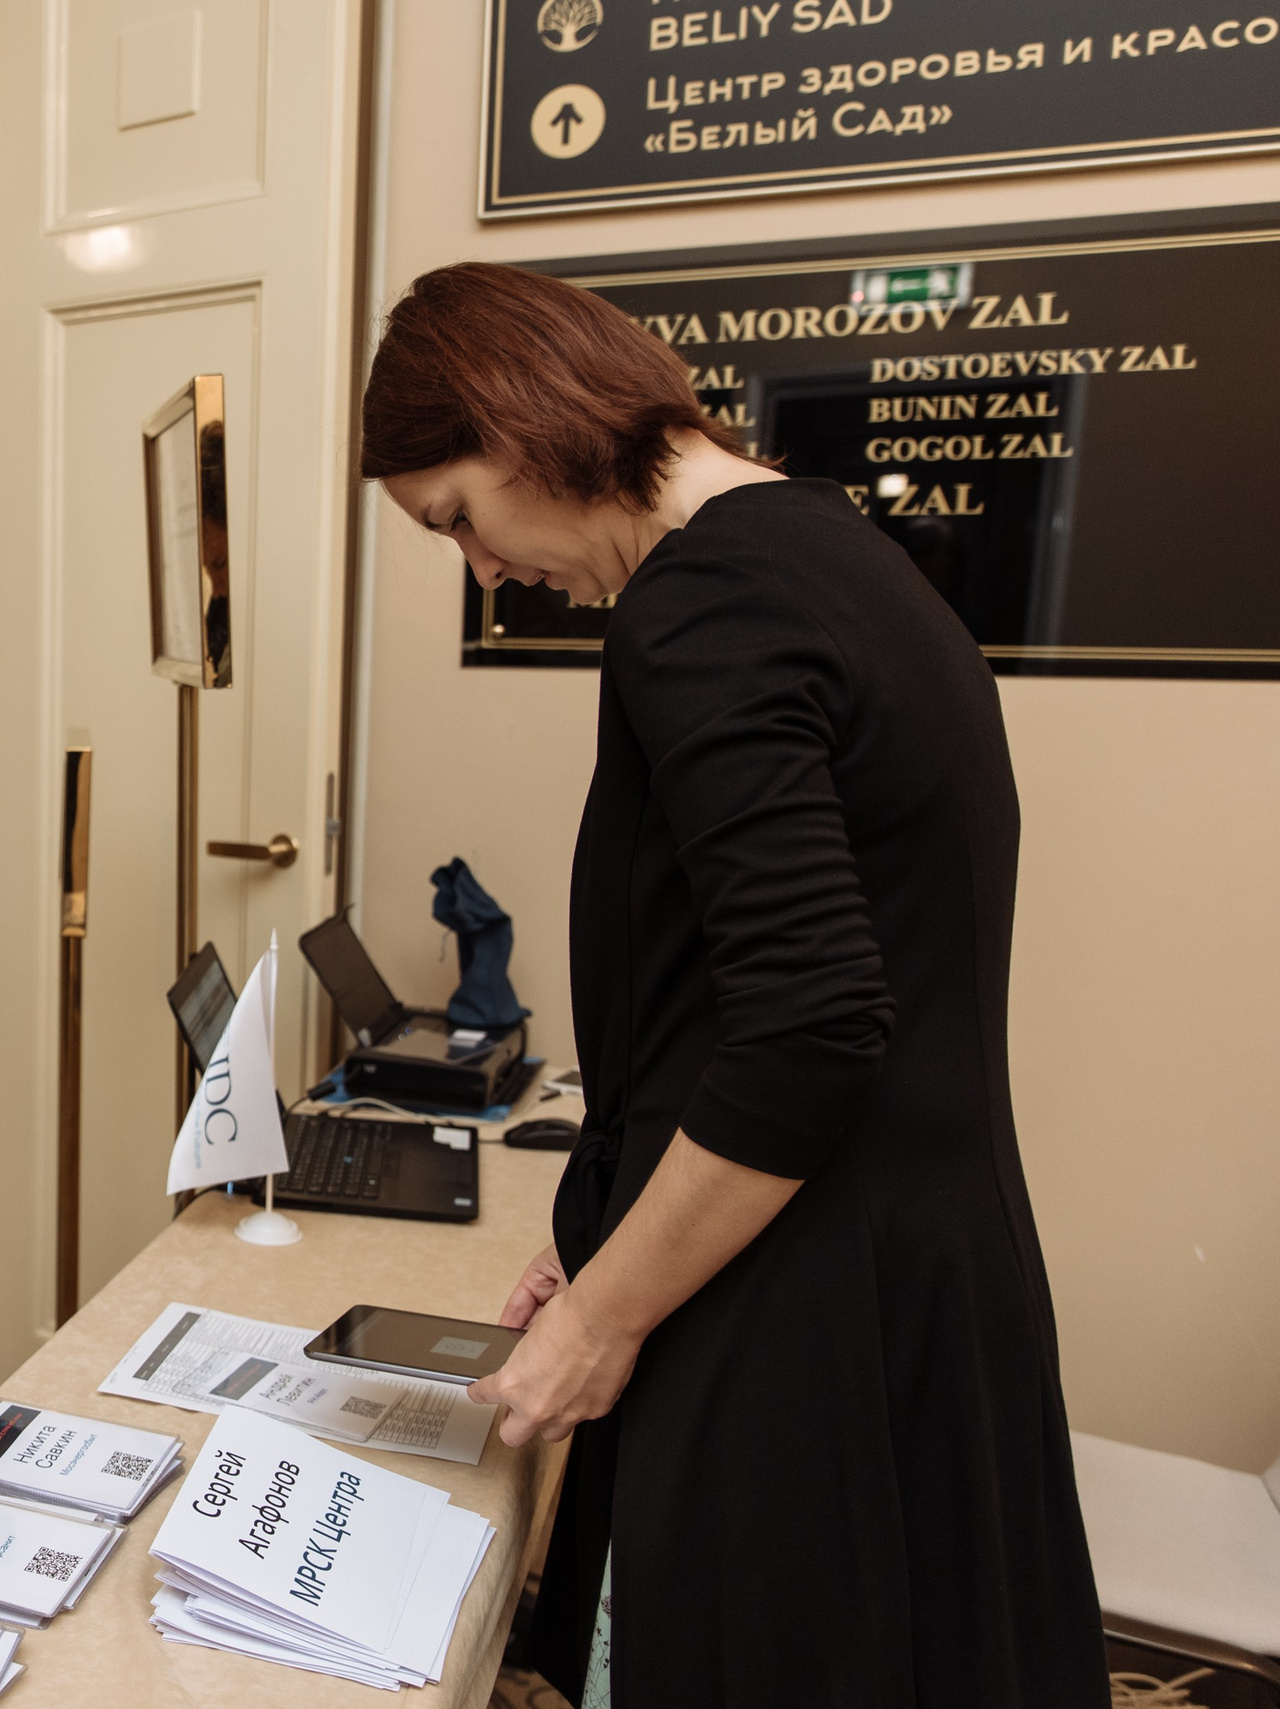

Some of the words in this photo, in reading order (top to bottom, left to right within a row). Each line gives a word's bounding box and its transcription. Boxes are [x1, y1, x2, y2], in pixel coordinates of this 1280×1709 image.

[649, 2, 781, 51] BELIY
[791, 0, 894, 34] SAD
[715, 299, 959, 344] MOROZOV
[967, 291, 1070, 330] ZAL
[870, 347, 1114, 384] DOSTOEVSKY
[1117, 343, 1198, 373] ZAL
[867, 394, 979, 424] BUNIN
[984, 391, 1060, 420] ZAL
[865, 434, 995, 464] GOGOL
[999, 432, 1075, 460] ZAL
[887, 483, 986, 517] ZAL
[204, 1054, 237, 1145] IDC
[12, 1426, 56, 1464] Никита
[35, 1430, 77, 1469] Савкин
[192, 1449, 246, 1518] Сергей
[312, 1471, 365, 1543] Центра
[238, 1460, 300, 1560] Агафонов
[289, 1538, 338, 1607] МРСК
